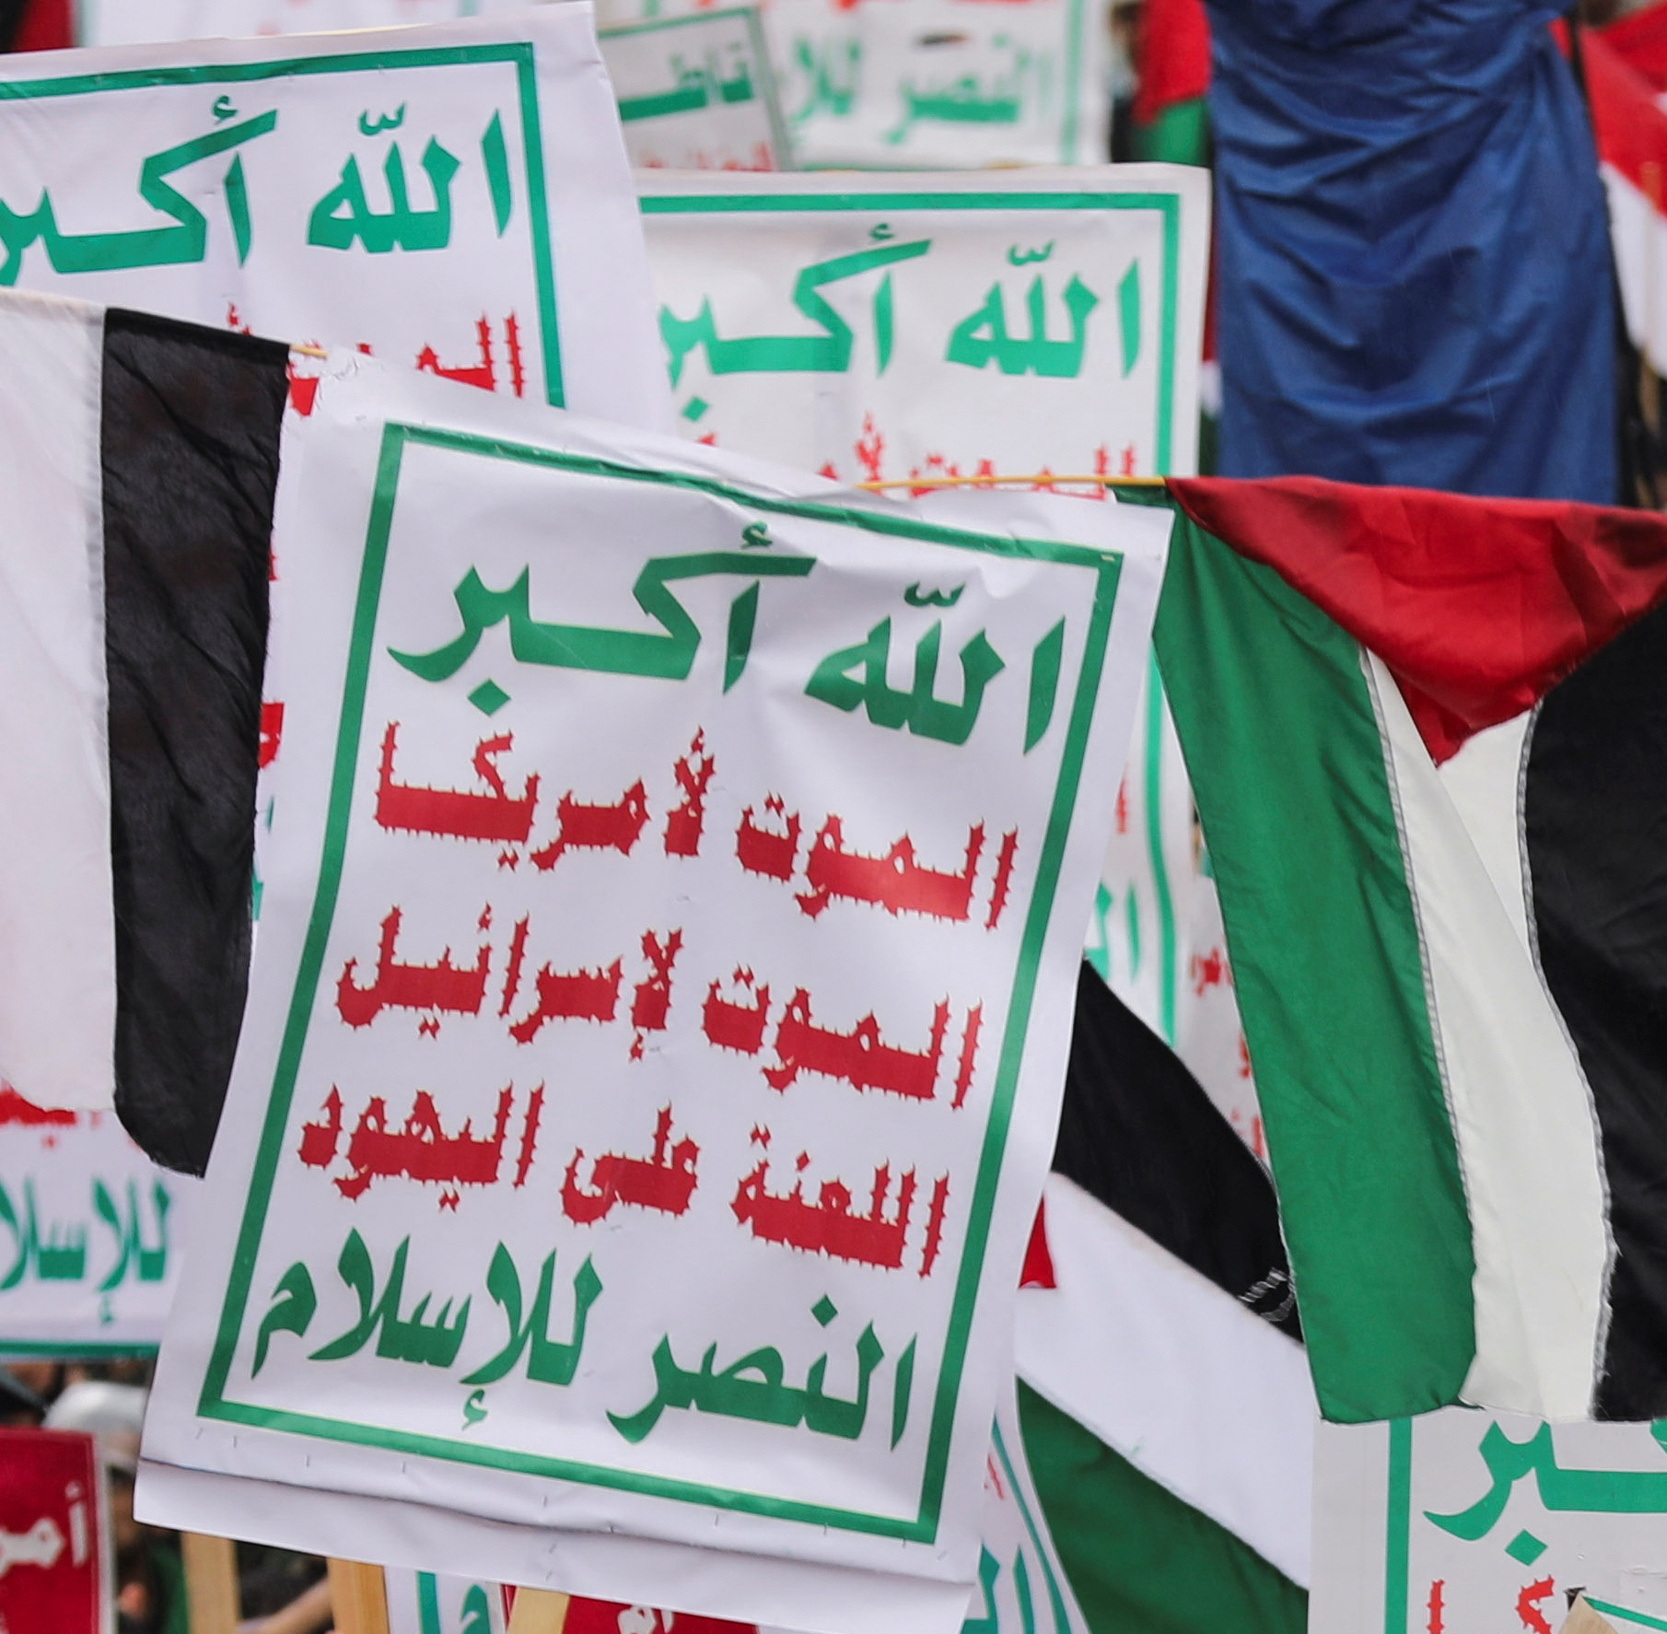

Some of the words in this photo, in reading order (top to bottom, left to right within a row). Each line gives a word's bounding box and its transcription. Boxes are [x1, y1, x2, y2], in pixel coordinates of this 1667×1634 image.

[389, 522, 815, 715] أكبر
[374, 723, 715, 871] لأمريكا
[736, 797, 1017, 928] الموت
[336, 906, 683, 1059] لإسرائيل
[702, 969, 982, 1108] الموت
[299, 1087, 544, 1208] اليهود
[560, 1102, 700, 1224] على
[731, 1129, 949, 1276] اللعنة
[254, 1230, 603, 1433] للإسلام
[608, 1297, 916, 1443] النصر
